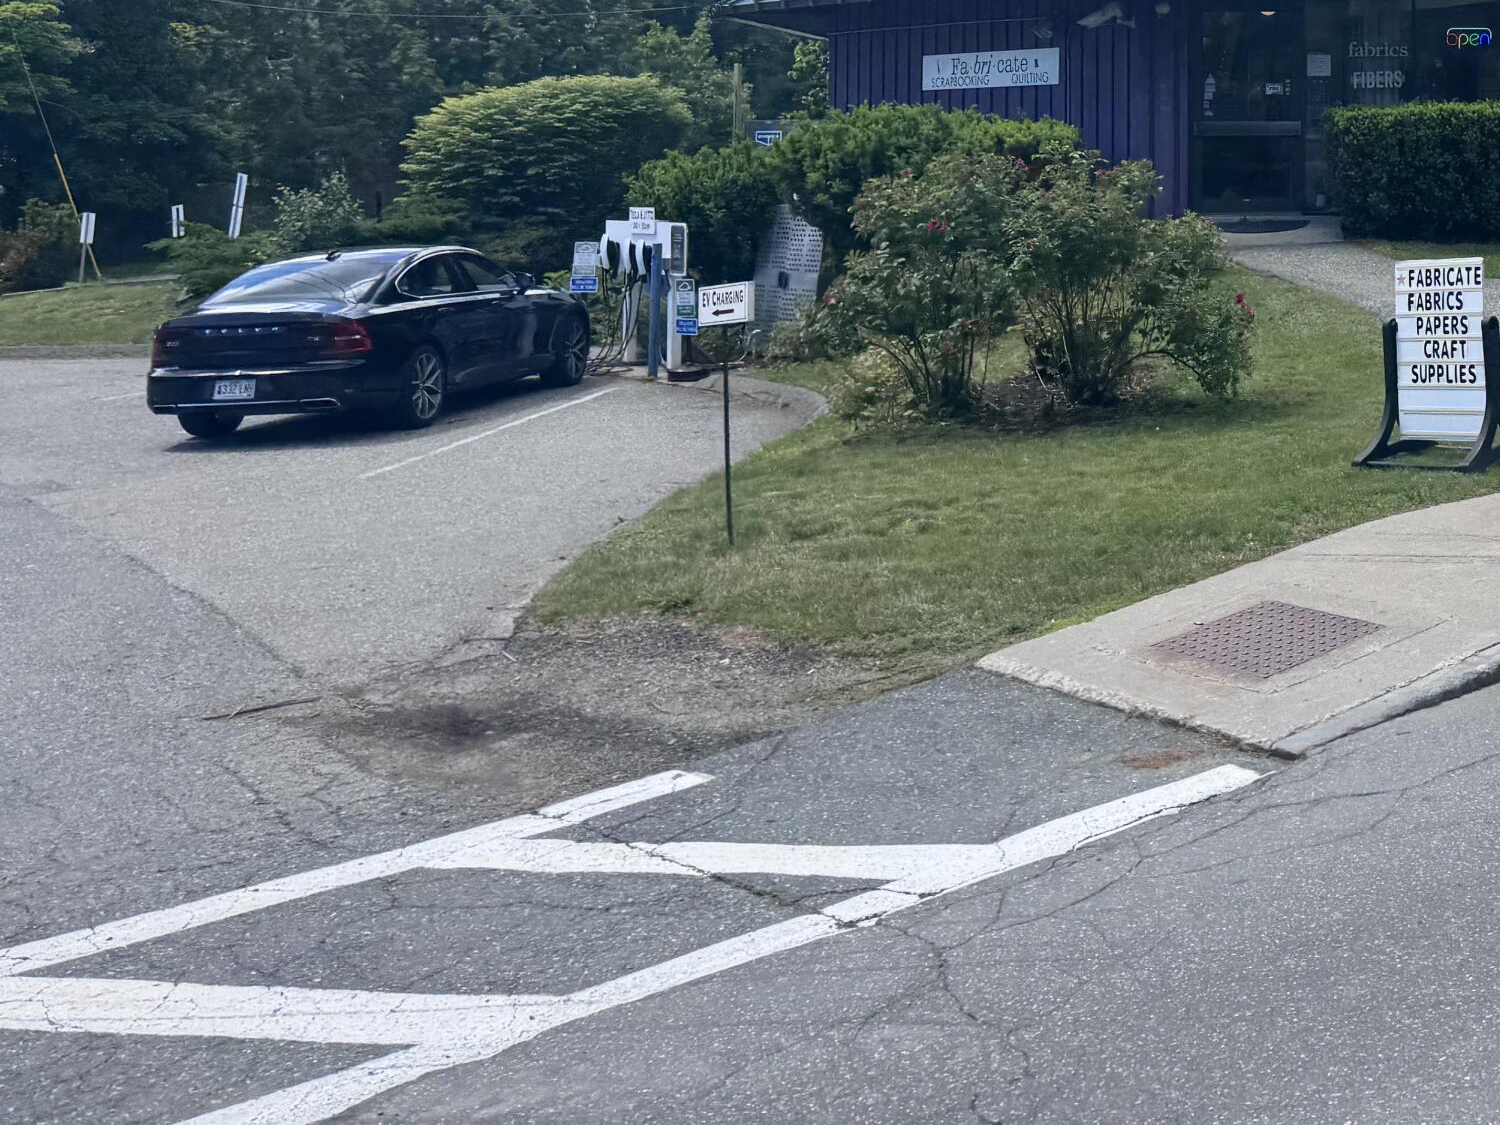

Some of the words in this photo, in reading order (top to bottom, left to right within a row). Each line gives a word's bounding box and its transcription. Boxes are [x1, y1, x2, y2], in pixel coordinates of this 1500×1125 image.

[1348, 41, 1408, 58] fabrics
[1446, 32, 1490, 50] open
[931, 75, 990, 88] SCRAPBOOKING
[1011, 72, 1049, 84] QUILTING
[1353, 70, 1403, 89] FIBERS
[1408, 266, 1482, 288] FABRICATE
[702, 292, 710, 307] EV
[711, 289, 744, 306] CHARGING
[1407, 291, 1464, 312] FABRICS
[1416, 315, 1469, 335] PAPERS
[1423, 340, 1467, 359] CRAFT
[1411, 364, 1477, 384] SUPPLIES
